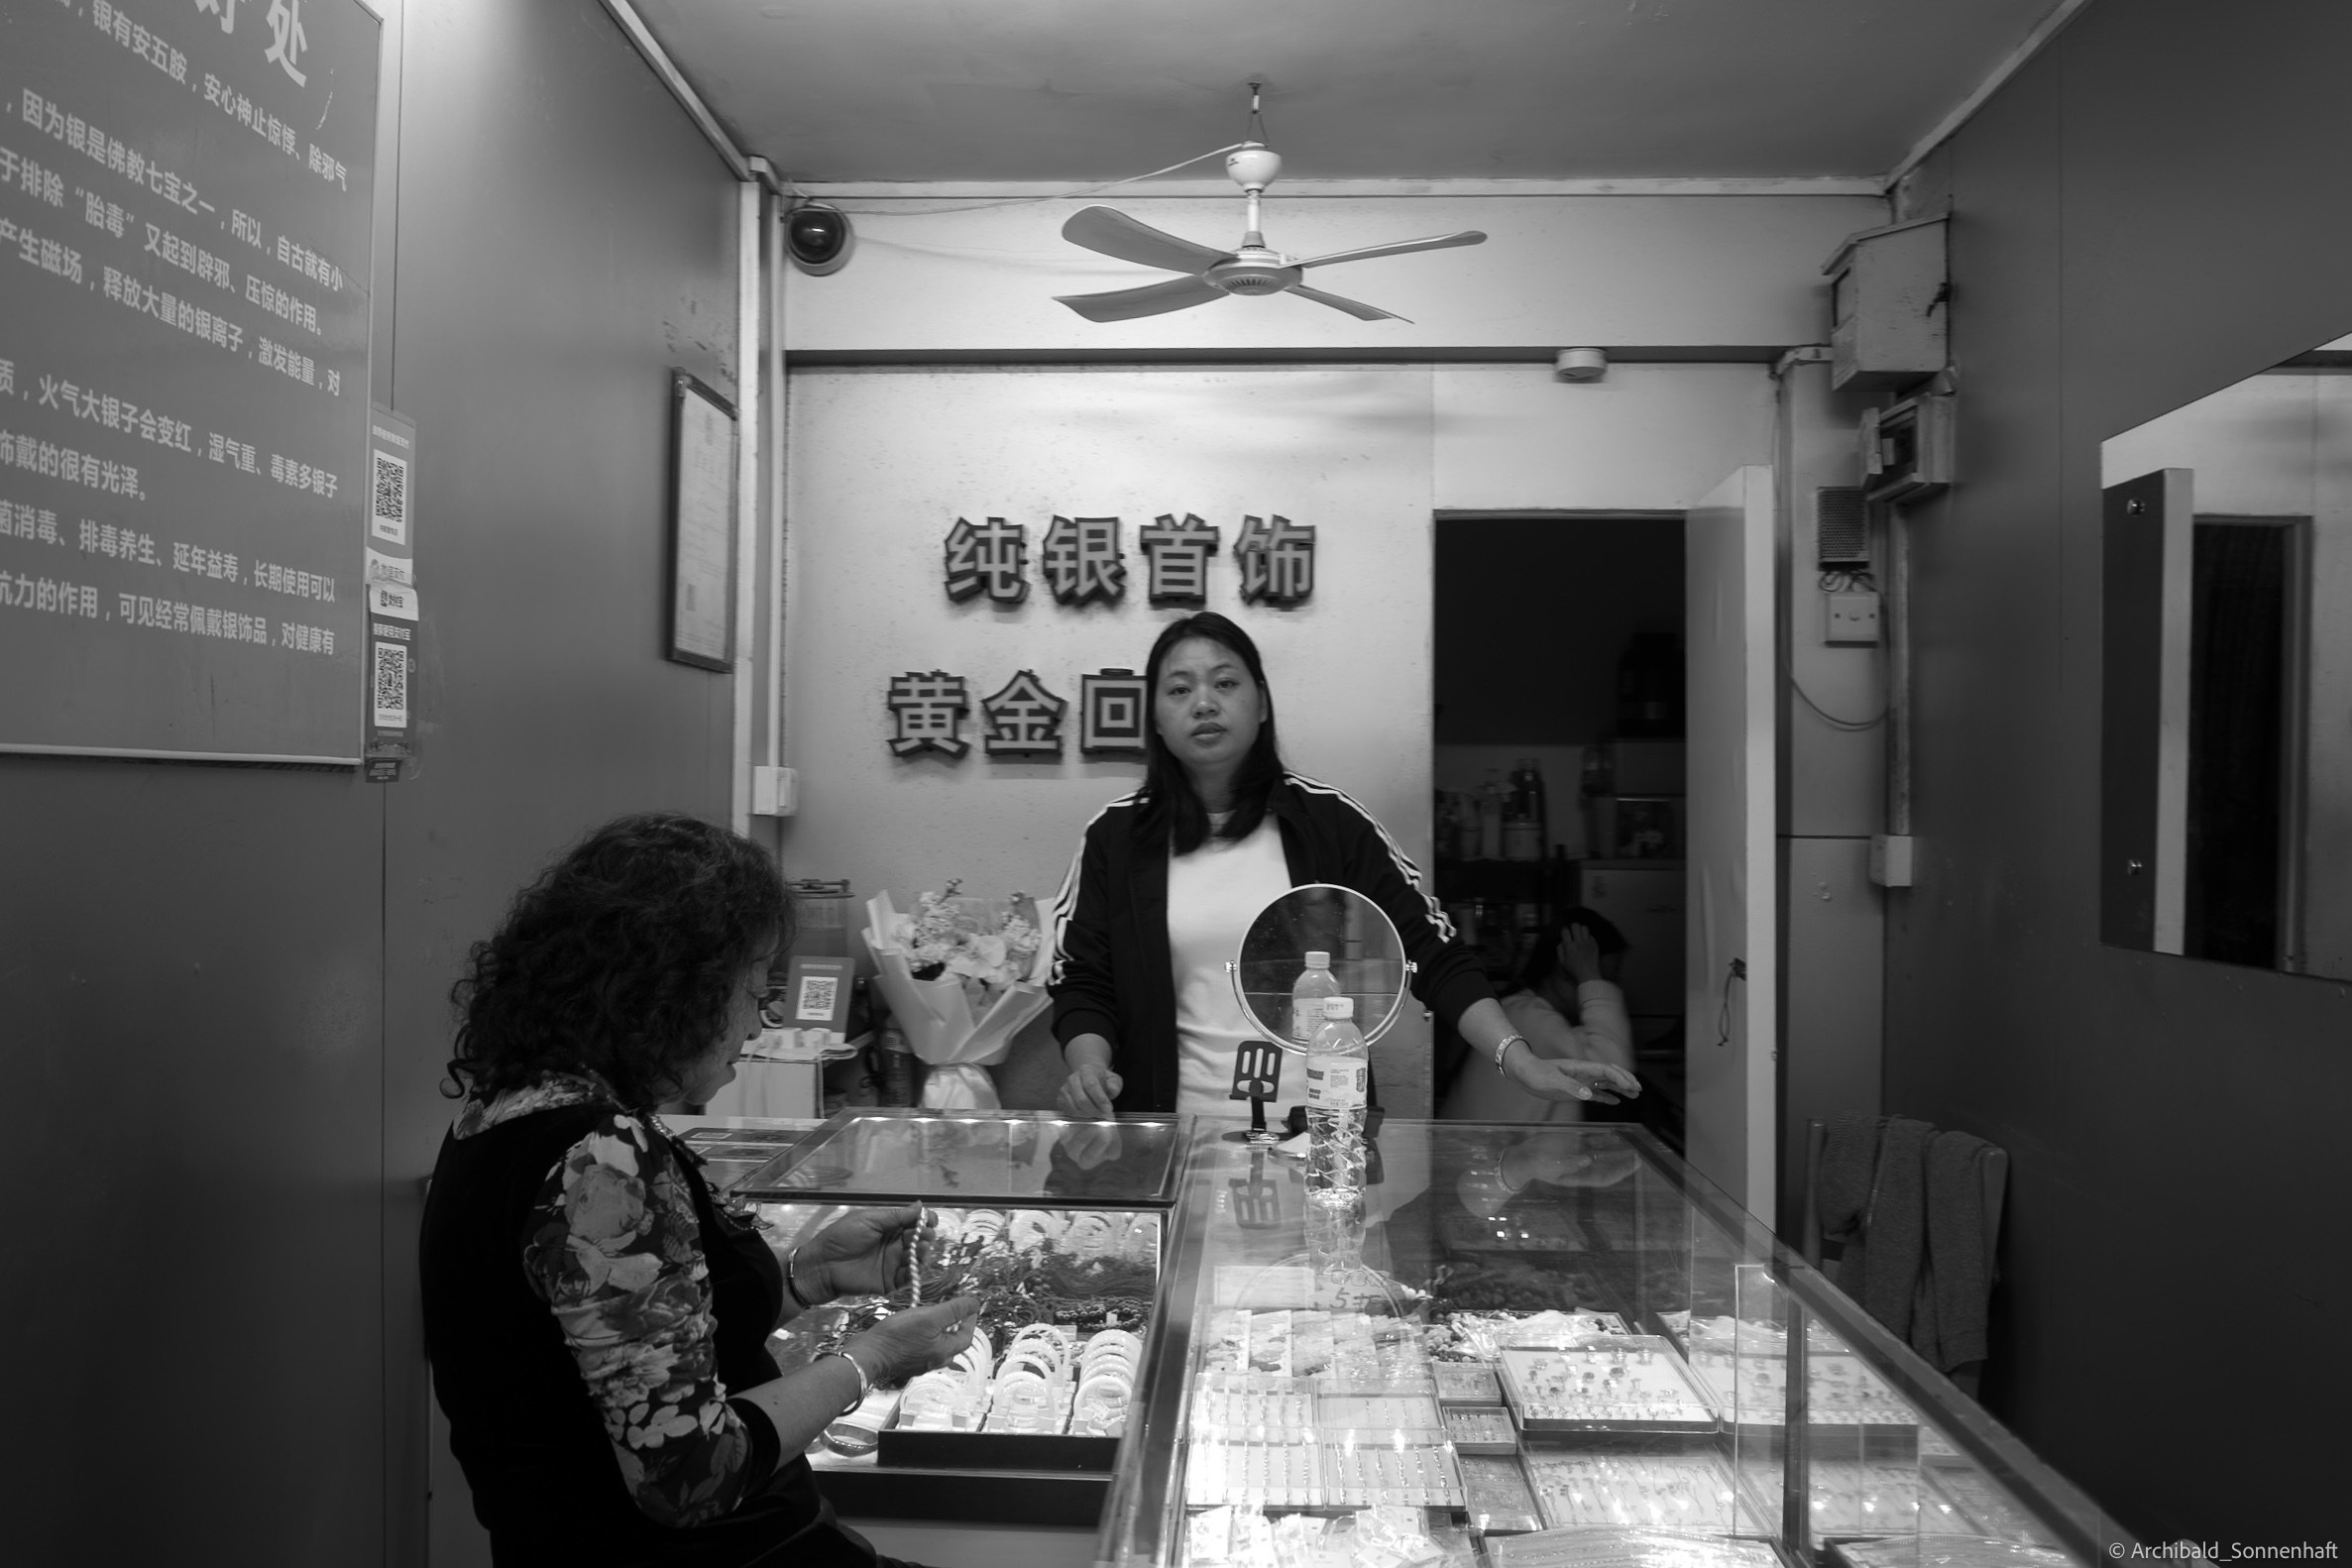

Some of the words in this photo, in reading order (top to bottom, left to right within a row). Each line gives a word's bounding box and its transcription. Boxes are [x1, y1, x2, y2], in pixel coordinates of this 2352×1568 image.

[944, 513, 1316, 605] 纯银首饰
[887, 668, 1147, 758] 黄金回
